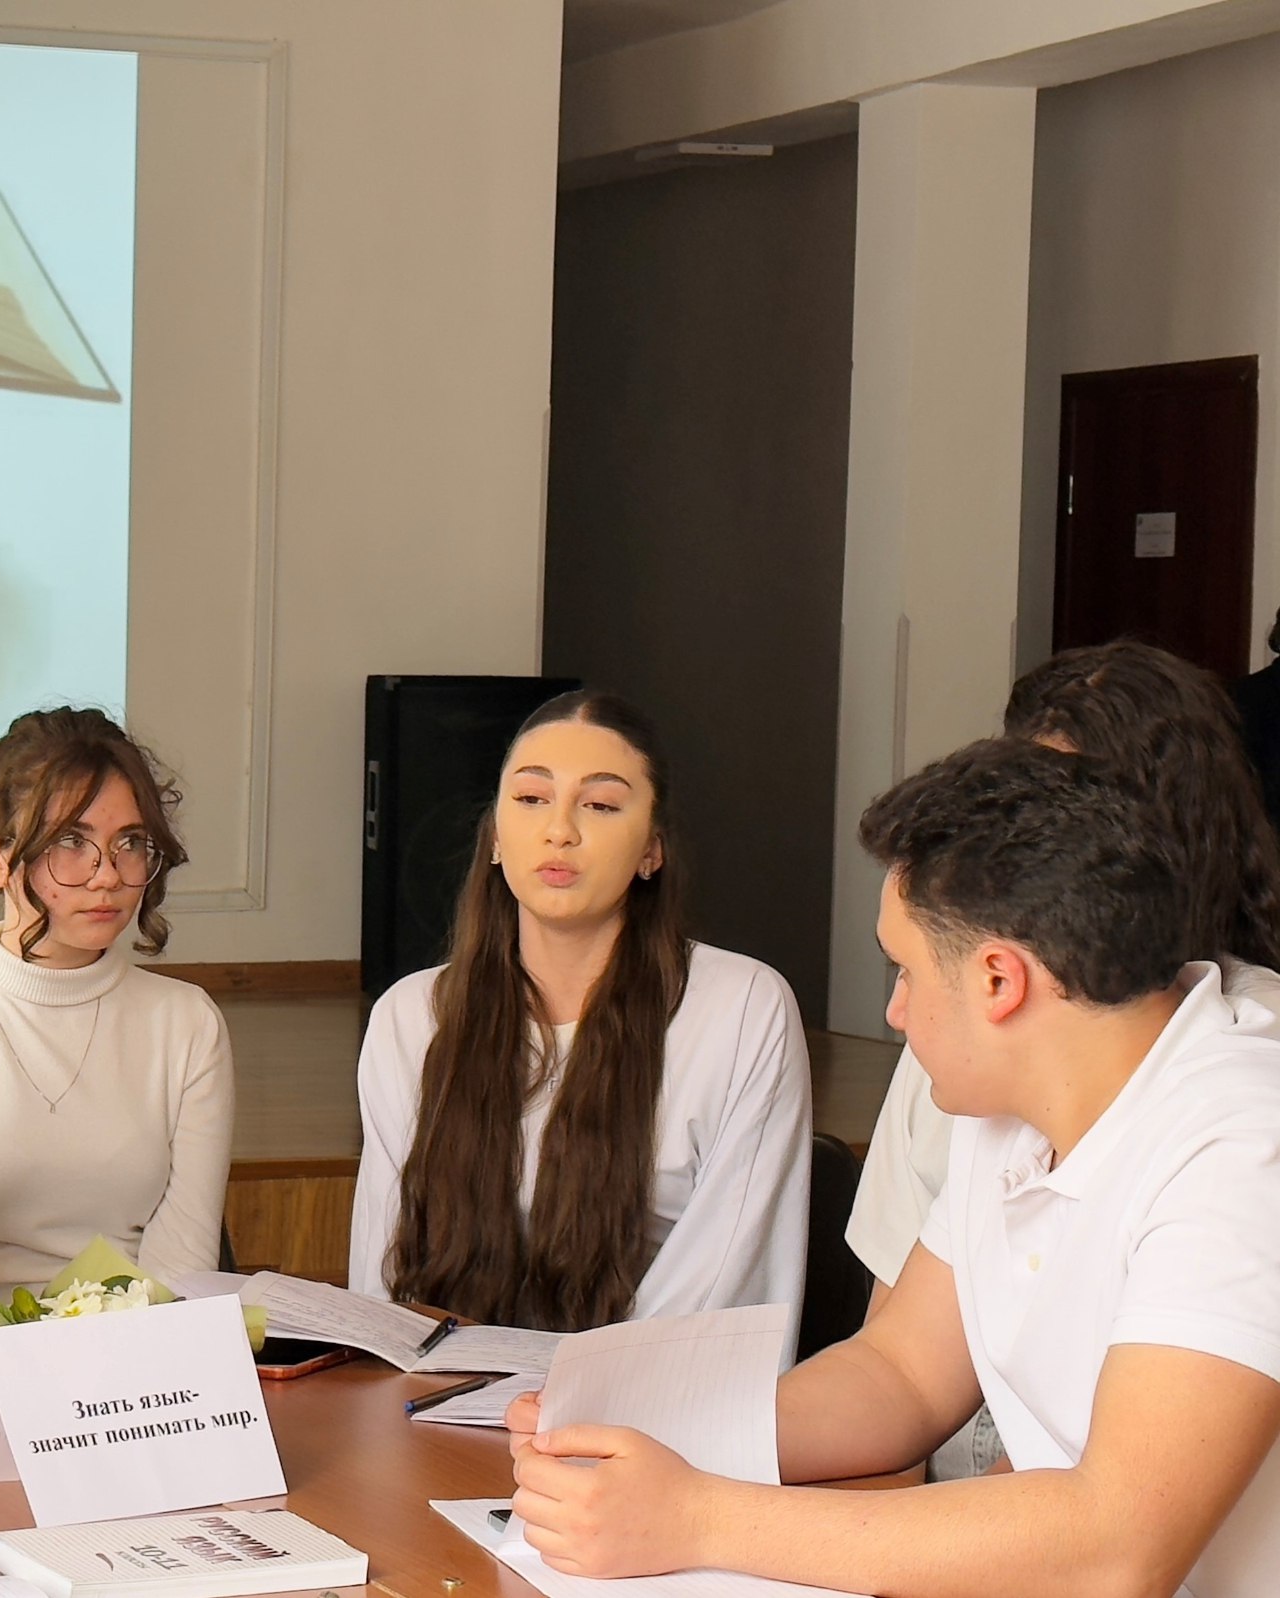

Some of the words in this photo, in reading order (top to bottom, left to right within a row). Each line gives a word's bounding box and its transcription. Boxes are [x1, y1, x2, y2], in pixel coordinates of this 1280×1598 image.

[71, 1400, 134, 1419] Знать
[139, 1388, 200, 1410] язык-
[28, 1434, 99, 1455] значит
[105, 1417, 206, 1445] понимать
[211, 1408, 259, 1432] мир.
[171, 1535, 243, 1565] ЯЗЫК
[190, 1516, 291, 1560] РУССКИЙ
[130, 1544, 189, 1570] 10-11
